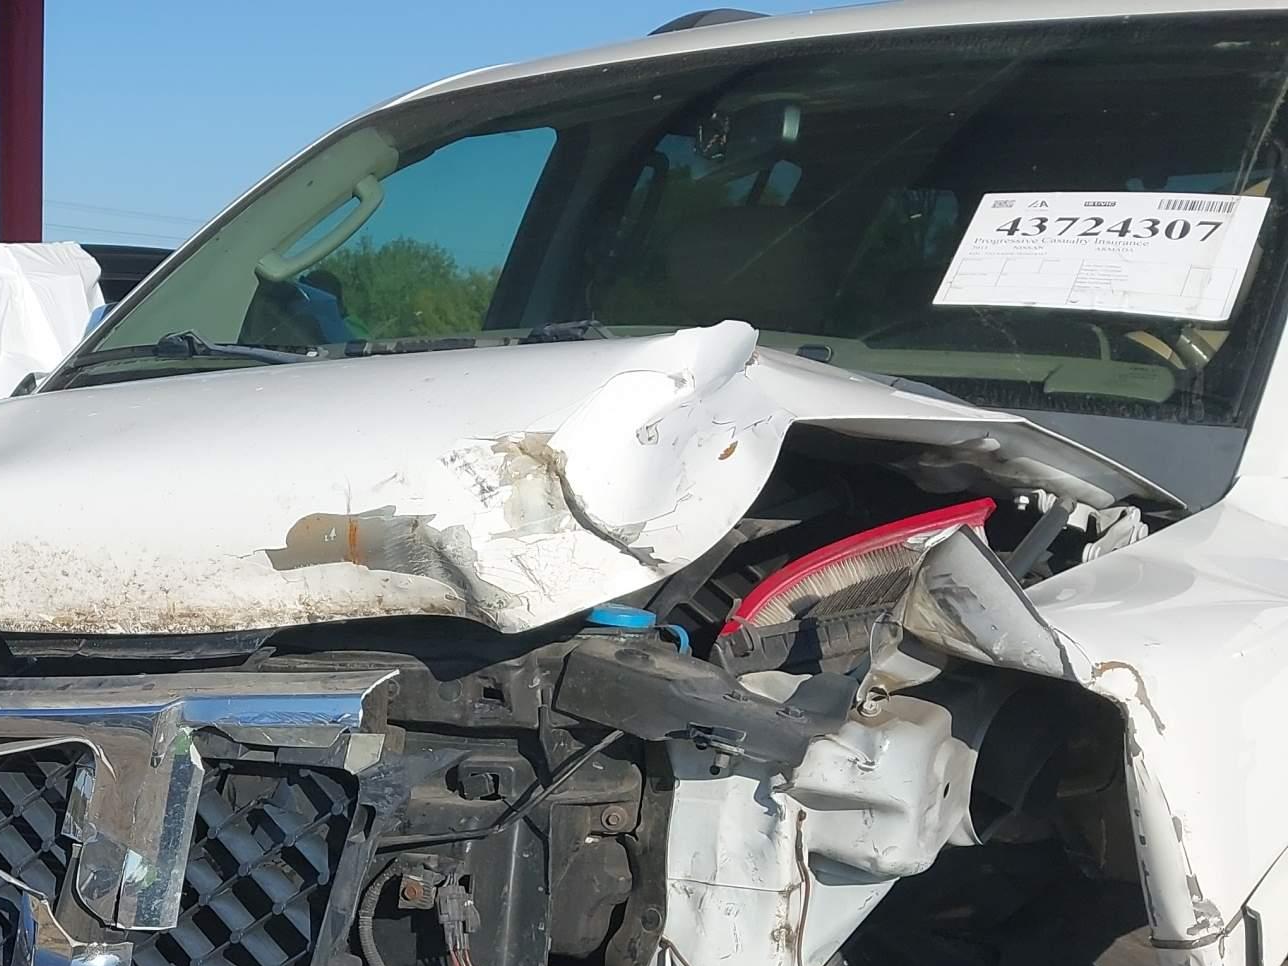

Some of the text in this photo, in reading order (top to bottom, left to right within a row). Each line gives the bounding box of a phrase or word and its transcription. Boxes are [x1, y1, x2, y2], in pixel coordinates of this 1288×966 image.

[995, 216, 1224, 242] 43724307
[1041, 238, 1089, 246] Casualty
[1094, 238, 1150, 247] Insurance
